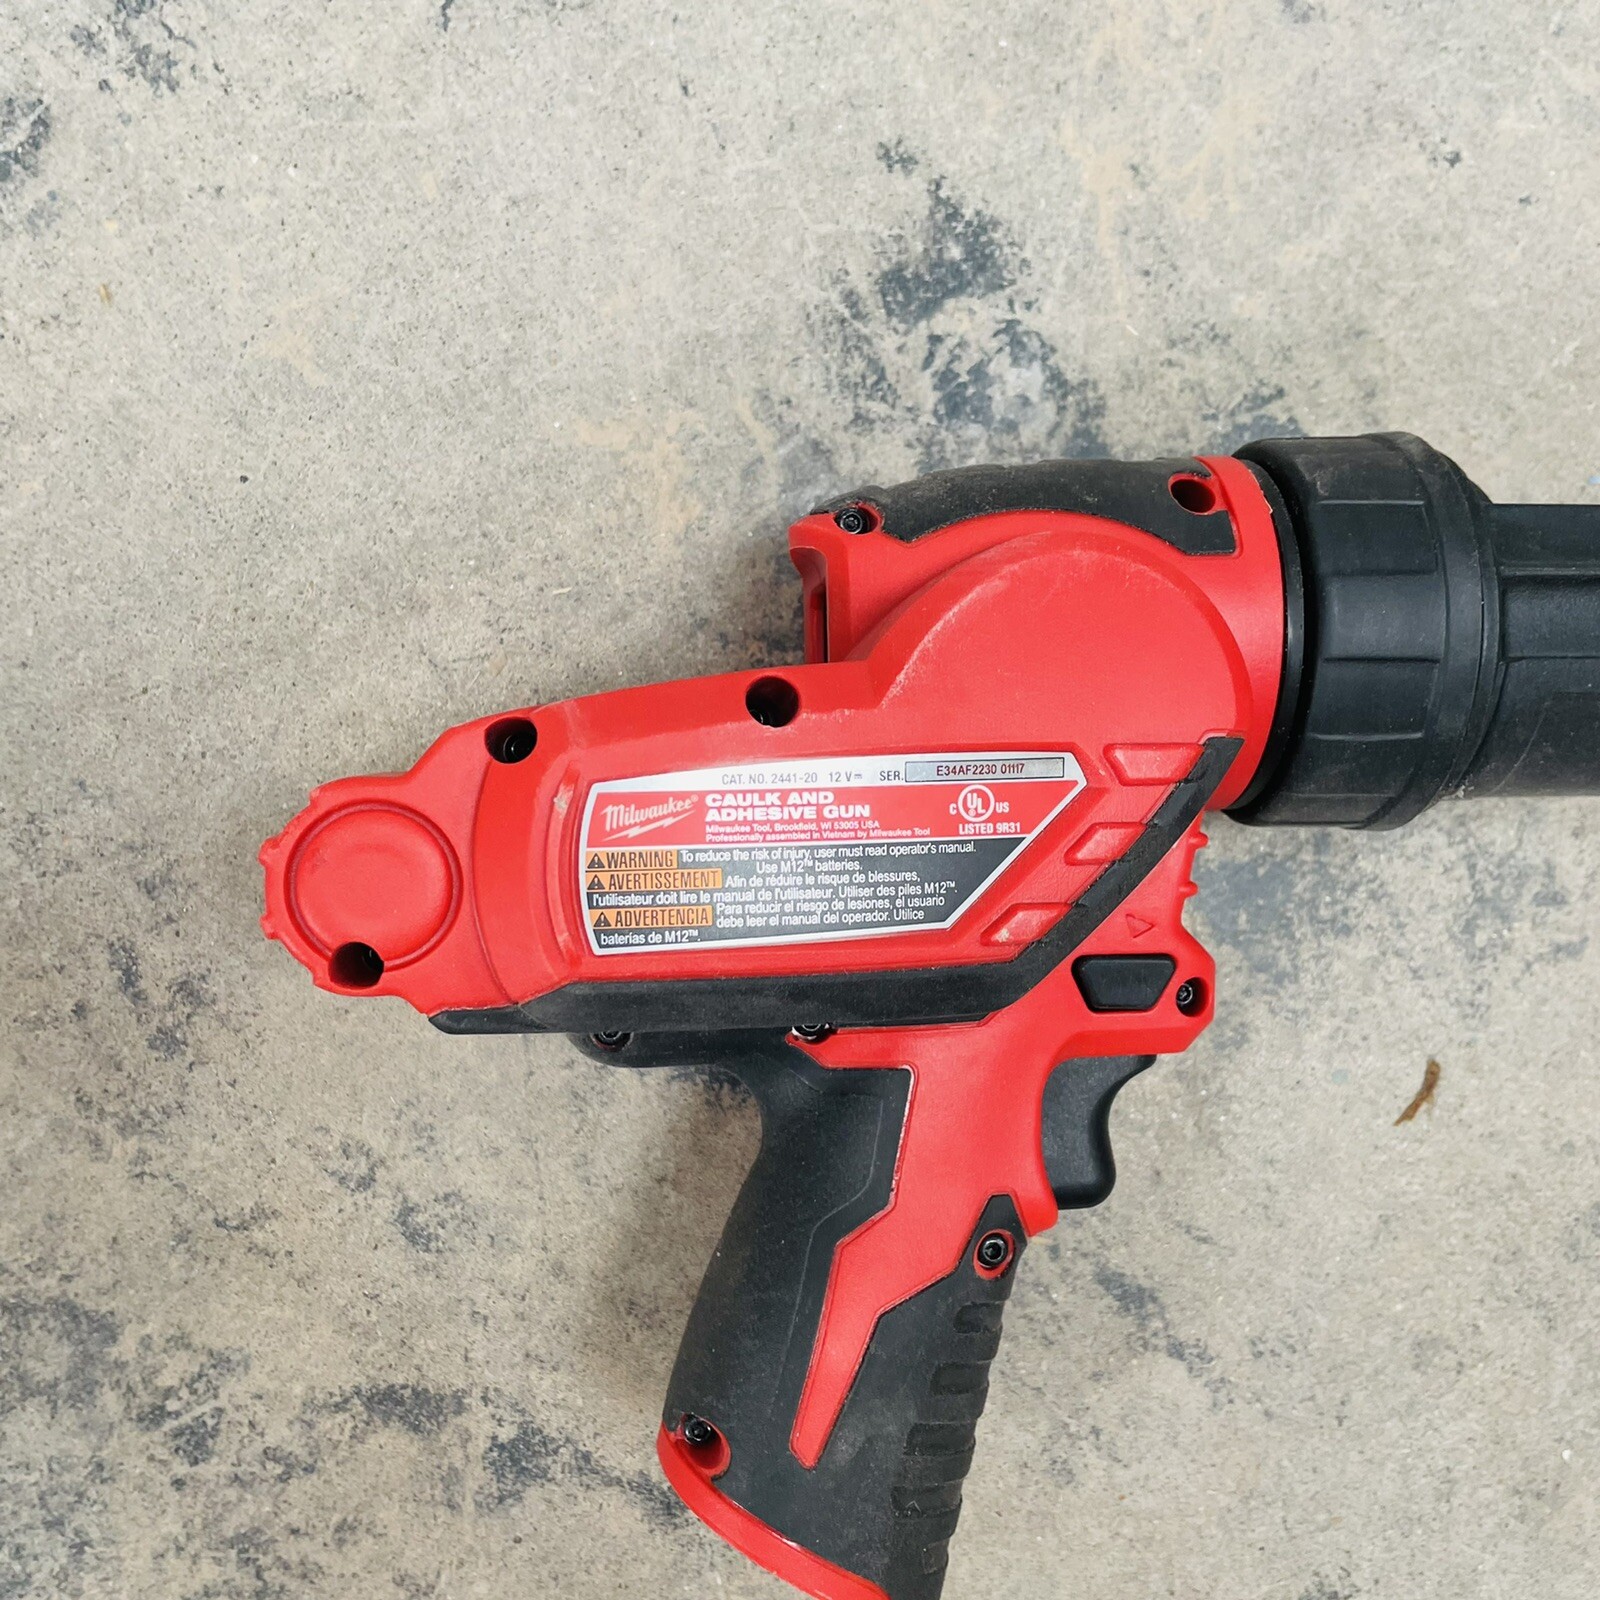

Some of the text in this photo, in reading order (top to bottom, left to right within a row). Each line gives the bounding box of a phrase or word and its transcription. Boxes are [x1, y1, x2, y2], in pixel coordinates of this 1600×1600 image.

[829, 772, 841, 782] 12
[880, 771, 904, 781] SER.
[936, 763, 1025, 776] E34AF2230 01117
[722, 773, 818, 785] CAT. NO. 2441-20
[705, 791, 835, 807] CAULK AND
[705, 805, 870, 822] ADHESIVE GUN
[996, 802, 1009, 813] US
[706, 823, 751, 833] Milwaukee
[820, 822, 832, 830] WI
[834, 821, 859, 830] 53005
[861, 820, 880, 829] USA
[959, 822, 1021, 835] LISTED 9R31
[706, 827, 930, 842] Professionally assembled in Vietnam by Milwaukee Tool
[680, 841, 976, 862] To reduce the risk of injury, user must read operator's manual.
[606, 850, 673, 869] WARNING
[756, 861, 778, 873] Use
[815, 859, 863, 871] batteries.
[608, 870, 719, 890] AVERTISSEMENT
[725, 871, 920, 888] Afin de réduire le risque de blessures,
[593, 892, 653, 906] l'utilisateur
[656, 891, 678, 905] doit
[680, 891, 698, 904] lire
[700, 891, 711, 903] le
[713, 889, 755, 902] manual
[757, 888, 772, 900] de
[774, 886, 835, 901] l'utilisateur.
[838, 884, 874, 898] Utiliser
[877, 883, 895, 896] des
[898, 881, 921, 896] piles
[716, 894, 945, 915] Para reducir el riesgo de lesiones, el usuario
[614, 908, 709, 927] ADVERTENCIA
[716, 908, 925, 928] debe leer el manual del operador. Utilice
[601, 931, 645, 945] baterías
[648, 931, 662, 943] de
